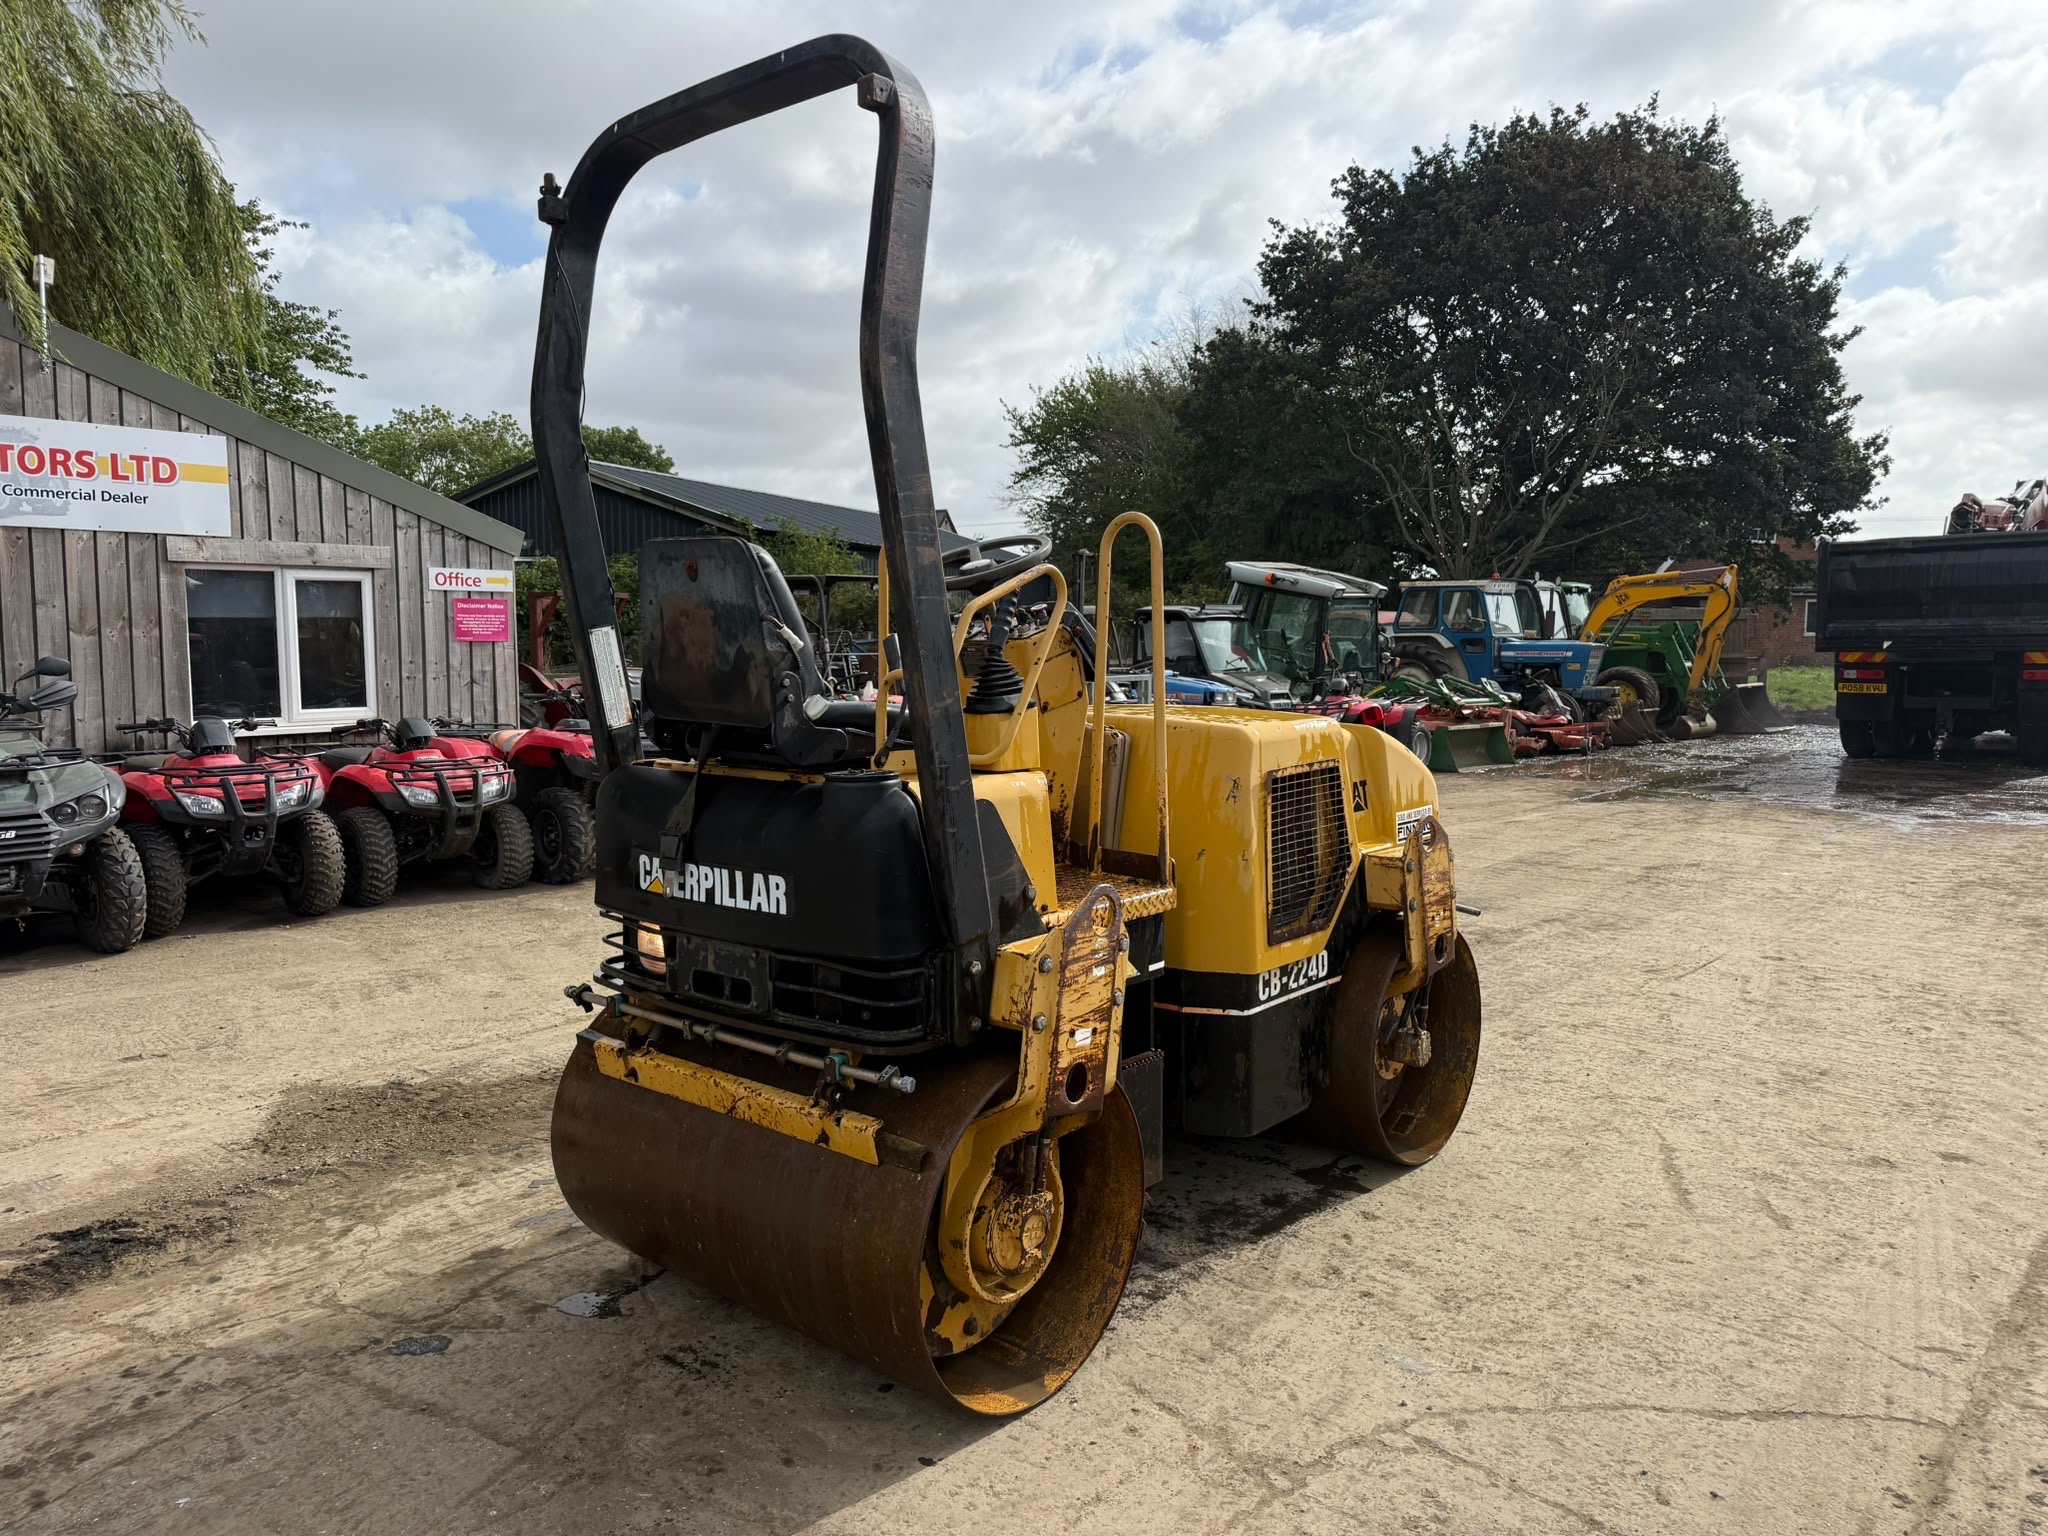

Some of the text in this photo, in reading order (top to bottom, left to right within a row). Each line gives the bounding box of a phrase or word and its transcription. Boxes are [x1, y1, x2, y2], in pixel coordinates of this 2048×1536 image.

[110, 452, 178, 484] LTD
[2, 484, 148, 504] Commercial Dealer
[435, 572, 481, 587] Office
[638, 854, 788, 916] CAERPILLAR
[1258, 949, 1328, 1001] CB-224D
